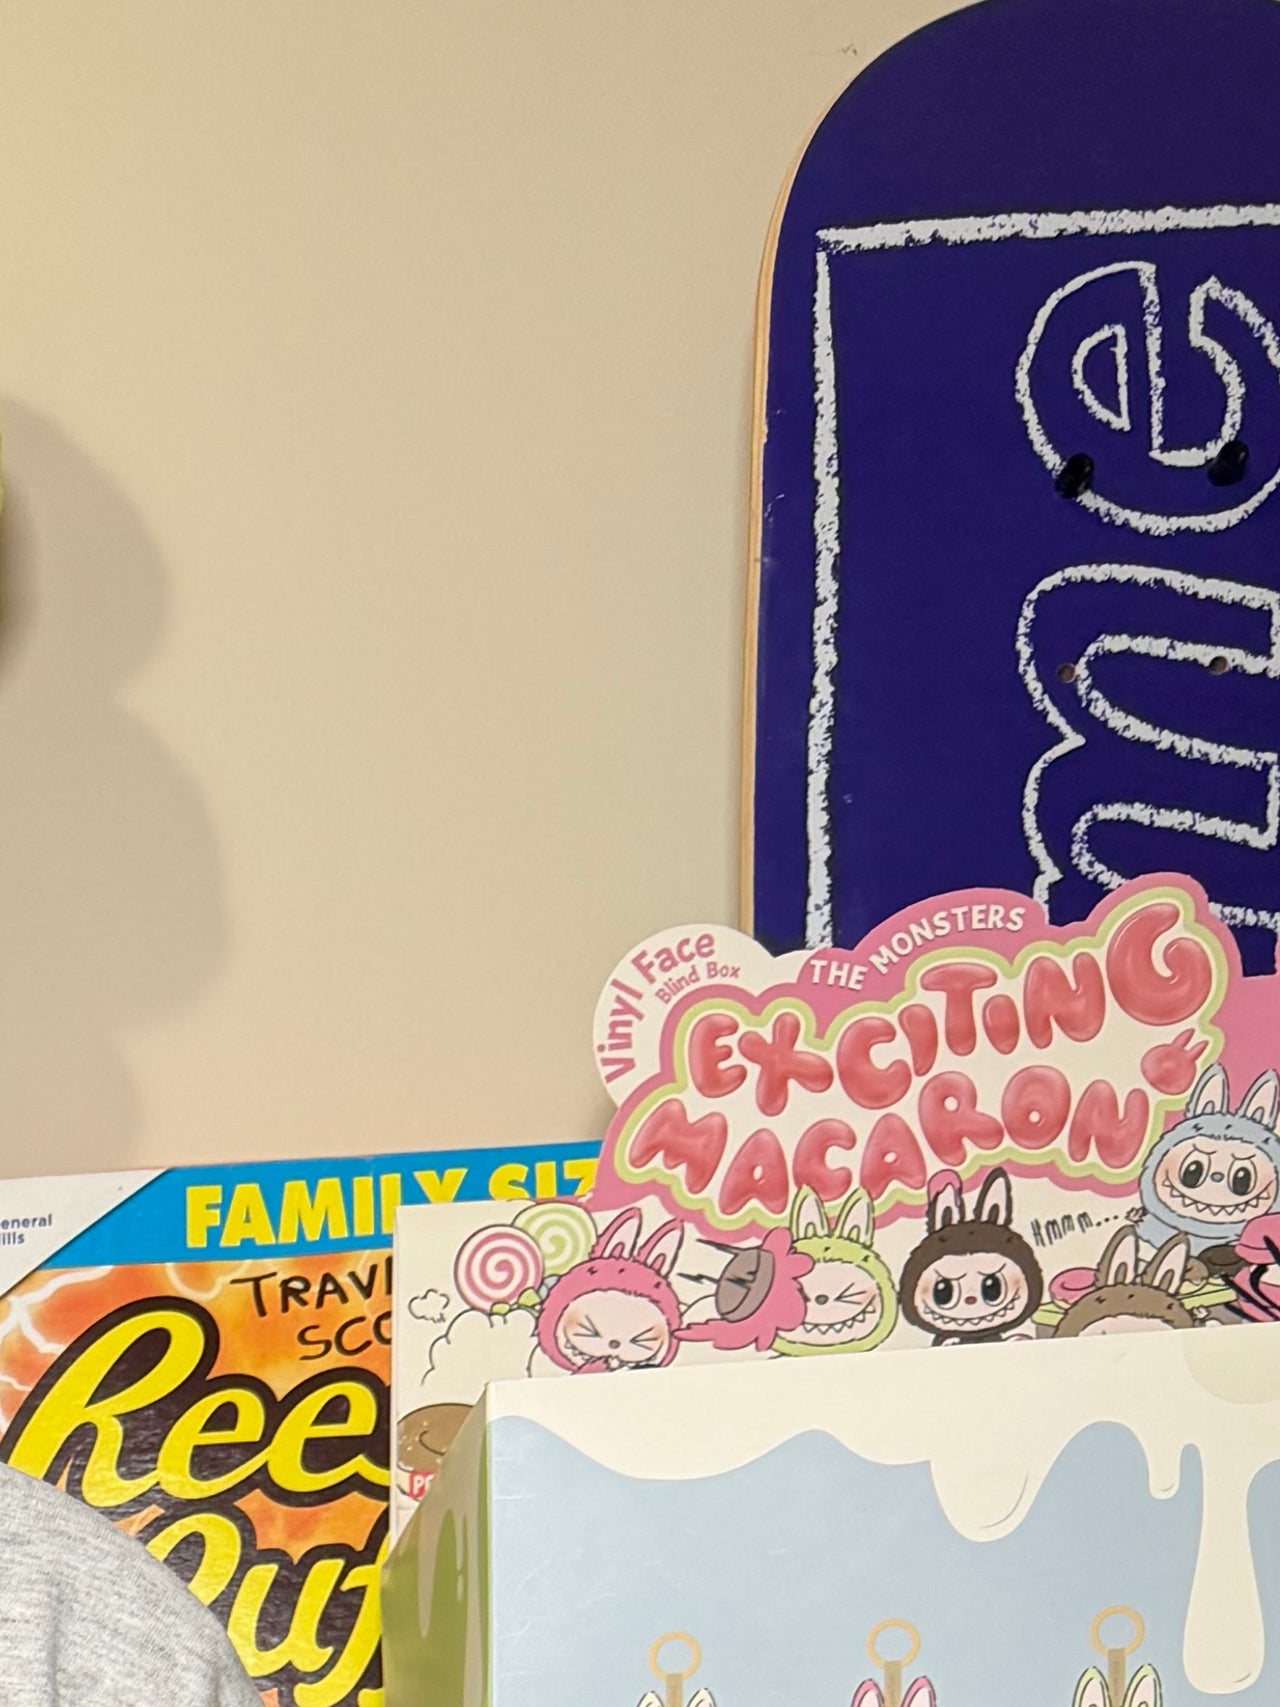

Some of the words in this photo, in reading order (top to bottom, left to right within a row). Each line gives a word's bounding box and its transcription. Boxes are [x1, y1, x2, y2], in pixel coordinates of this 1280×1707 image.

[654, 965, 703, 1006] Blind
[704, 959, 742, 982] Box
[808, 960, 869, 993] THE
[870, 904, 1027, 976] MONSTERS
[598, 976, 646, 1085] Vinyl
[630, 930, 717, 985] Face
[687, 901, 1214, 1118] EXCITING
[628, 1064, 1152, 1216] MACARON
[488, 1156, 601, 1201] SIZ
[231, 1255, 393, 1318] TRAVI
[297, 1310, 393, 1361] SCO
